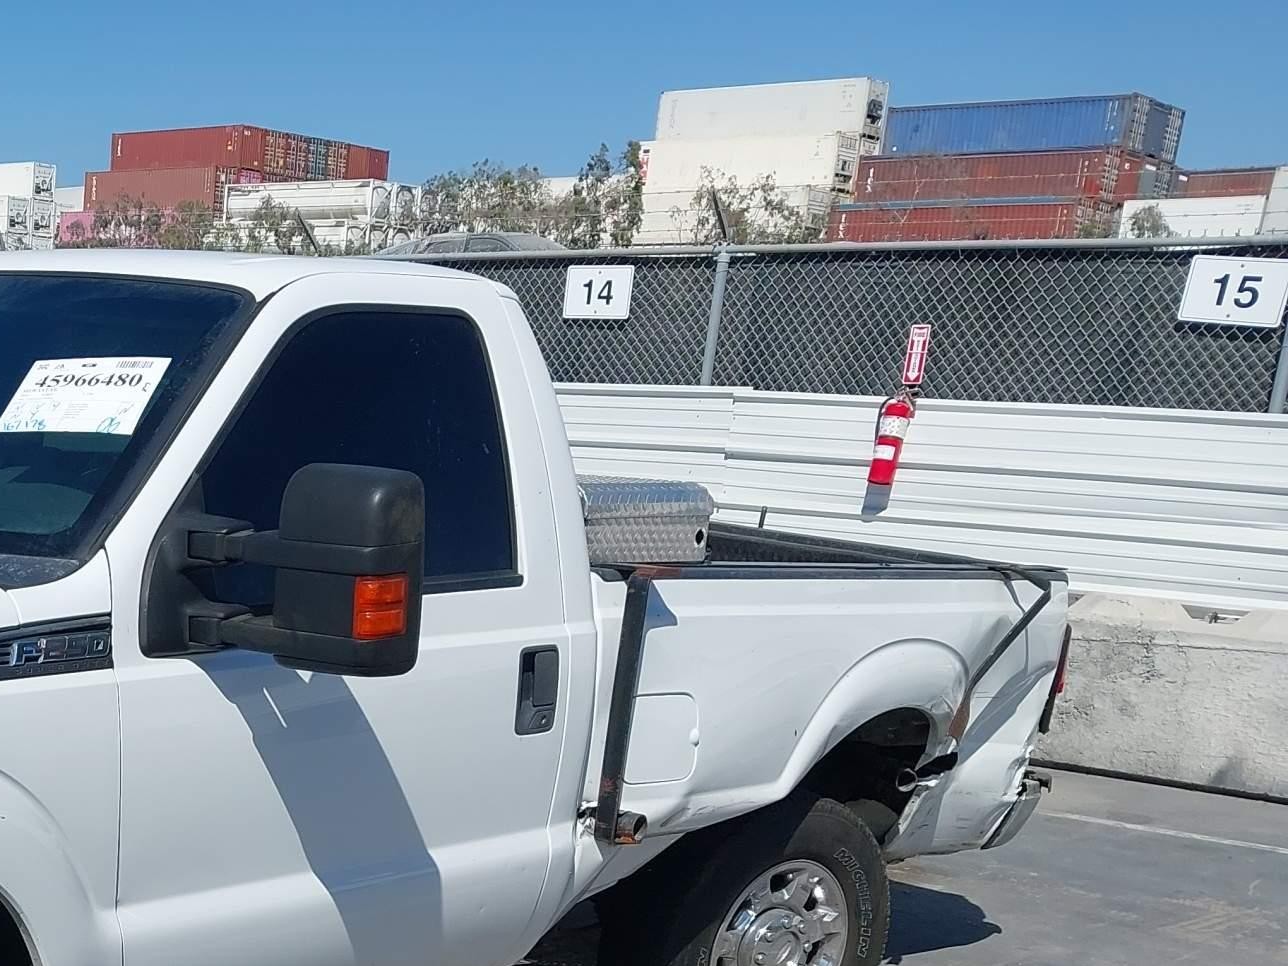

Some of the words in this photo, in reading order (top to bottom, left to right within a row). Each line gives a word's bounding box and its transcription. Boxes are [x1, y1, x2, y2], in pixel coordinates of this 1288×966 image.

[583, 279, 614, 305] 14
[1214, 273, 1263, 309] 15
[35, 373, 143, 388] 45966480
[833, 848, 873, 958] MICHELIN
